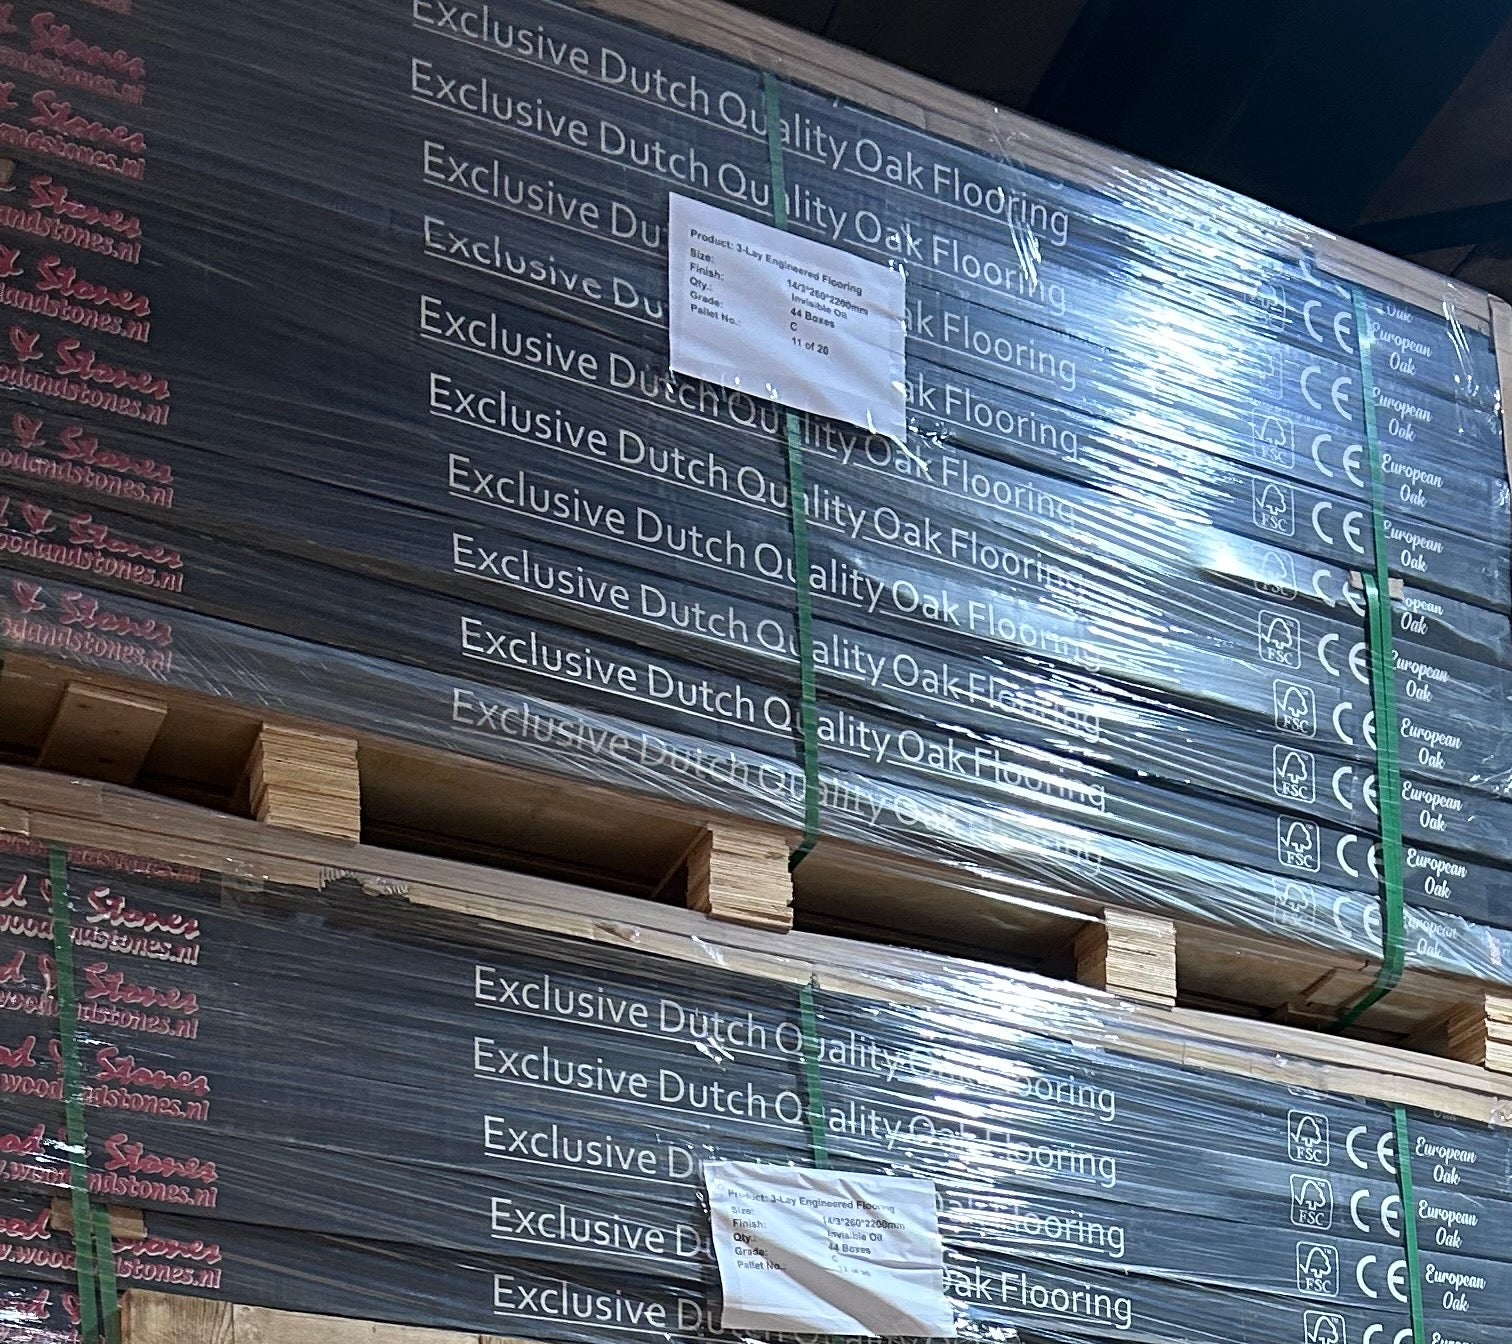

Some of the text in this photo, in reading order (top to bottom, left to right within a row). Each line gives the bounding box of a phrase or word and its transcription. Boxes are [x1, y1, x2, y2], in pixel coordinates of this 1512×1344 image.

[412, 0, 589, 75] Exclusive
[601, 47, 709, 116] Dutch
[855, 138, 924, 190] Oak
[933, 163, 1069, 247] Flooring
[412, 57, 1067, 317] Exclusive Dutch Oak Flooring
[424, 140, 599, 229] Exclusive
[424, 215, 601, 300] Exclusive
[690, 229, 863, 297] Product: 3-Lay Engineered Flooring
[37, 255, 151, 317] Stones
[689, 263, 724, 280] Finish:
[791, 293, 832, 315] Invisible
[690, 304, 719, 319] Pallet
[791, 337, 802, 347] 11
[804, 341, 815, 352] of
[789, 321, 798, 332] C
[790, 308, 836, 328] 44 Boxes
[943, 310, 1077, 391] Flooring
[1371, 322, 1434, 358] European
[56, 339, 170, 400] Stones
[1389, 352, 1417, 376] Oak
[420, 295, 598, 380] Exclusive
[865, 434, 934, 482] Oak
[1372, 387, 1433, 422] European
[945, 381, 1079, 458] Flooring
[1388, 418, 1416, 442] Oak
[59, 427, 174, 483] Stones
[430, 372, 608, 456] Exclusive
[619, 429, 727, 491] Dutch
[873, 507, 943, 555] Oak
[1381, 454, 1444, 488] European
[1400, 484, 1427, 507] Oak
[449, 453, 625, 535] Exclusive
[636, 506, 745, 569] Dutch
[892, 579, 960, 627] Oak
[1261, 513, 1287, 531] FSC
[1383, 520, 1444, 553] European
[69, 514, 183, 569] Stones
[1400, 550, 1428, 572] Oak
[453, 532, 629, 610] Exclusive
[640, 584, 748, 643] Dutch
[893, 654, 960, 700] Oak
[1400, 612, 1428, 635] Oak
[1267, 648, 1293, 665] FSC
[461, 617, 637, 691] Exclusive
[648, 664, 754, 722] Dutch
[898, 730, 966, 774] Oak
[1405, 680, 1433, 702] Oak
[452, 688, 630, 757] Exclusive
[1284, 716, 1309, 733] FSC
[1400, 718, 1462, 749] European
[1418, 747, 1446, 769] Oak
[1401, 781, 1463, 812] European
[1419, 810, 1447, 831] Oak
[1286, 851, 1313, 867] FSC
[1406, 848, 1468, 878] European
[1424, 876, 1452, 899] Oak
[86, 887, 201, 940] Stones
[83, 962, 198, 1015] Stones
[475, 964, 765, 1051] Exclusive Dutch
[96, 1047, 210, 1096] Stones
[474, 1036, 765, 1119] Exclusive Dutch
[105, 1133, 218, 1183] Stones
[484, 1115, 656, 1175] Exclusive
[1296, 1147, 1322, 1162] FSC
[1416, 1136, 1477, 1164] European
[1433, 1164, 1460, 1186] Oak
[491, 1197, 665, 1256] Exclusive
[1418, 1200, 1479, 1227] European
[1435, 1226, 1463, 1249] Oak
[1305, 1278, 1332, 1293] FSC
[1425, 1264, 1487, 1290] European
[493, 1273, 667, 1329] Exclusive
[1001, 1272, 1132, 1330] Flooring
[1442, 1291, 1470, 1312] Oak
